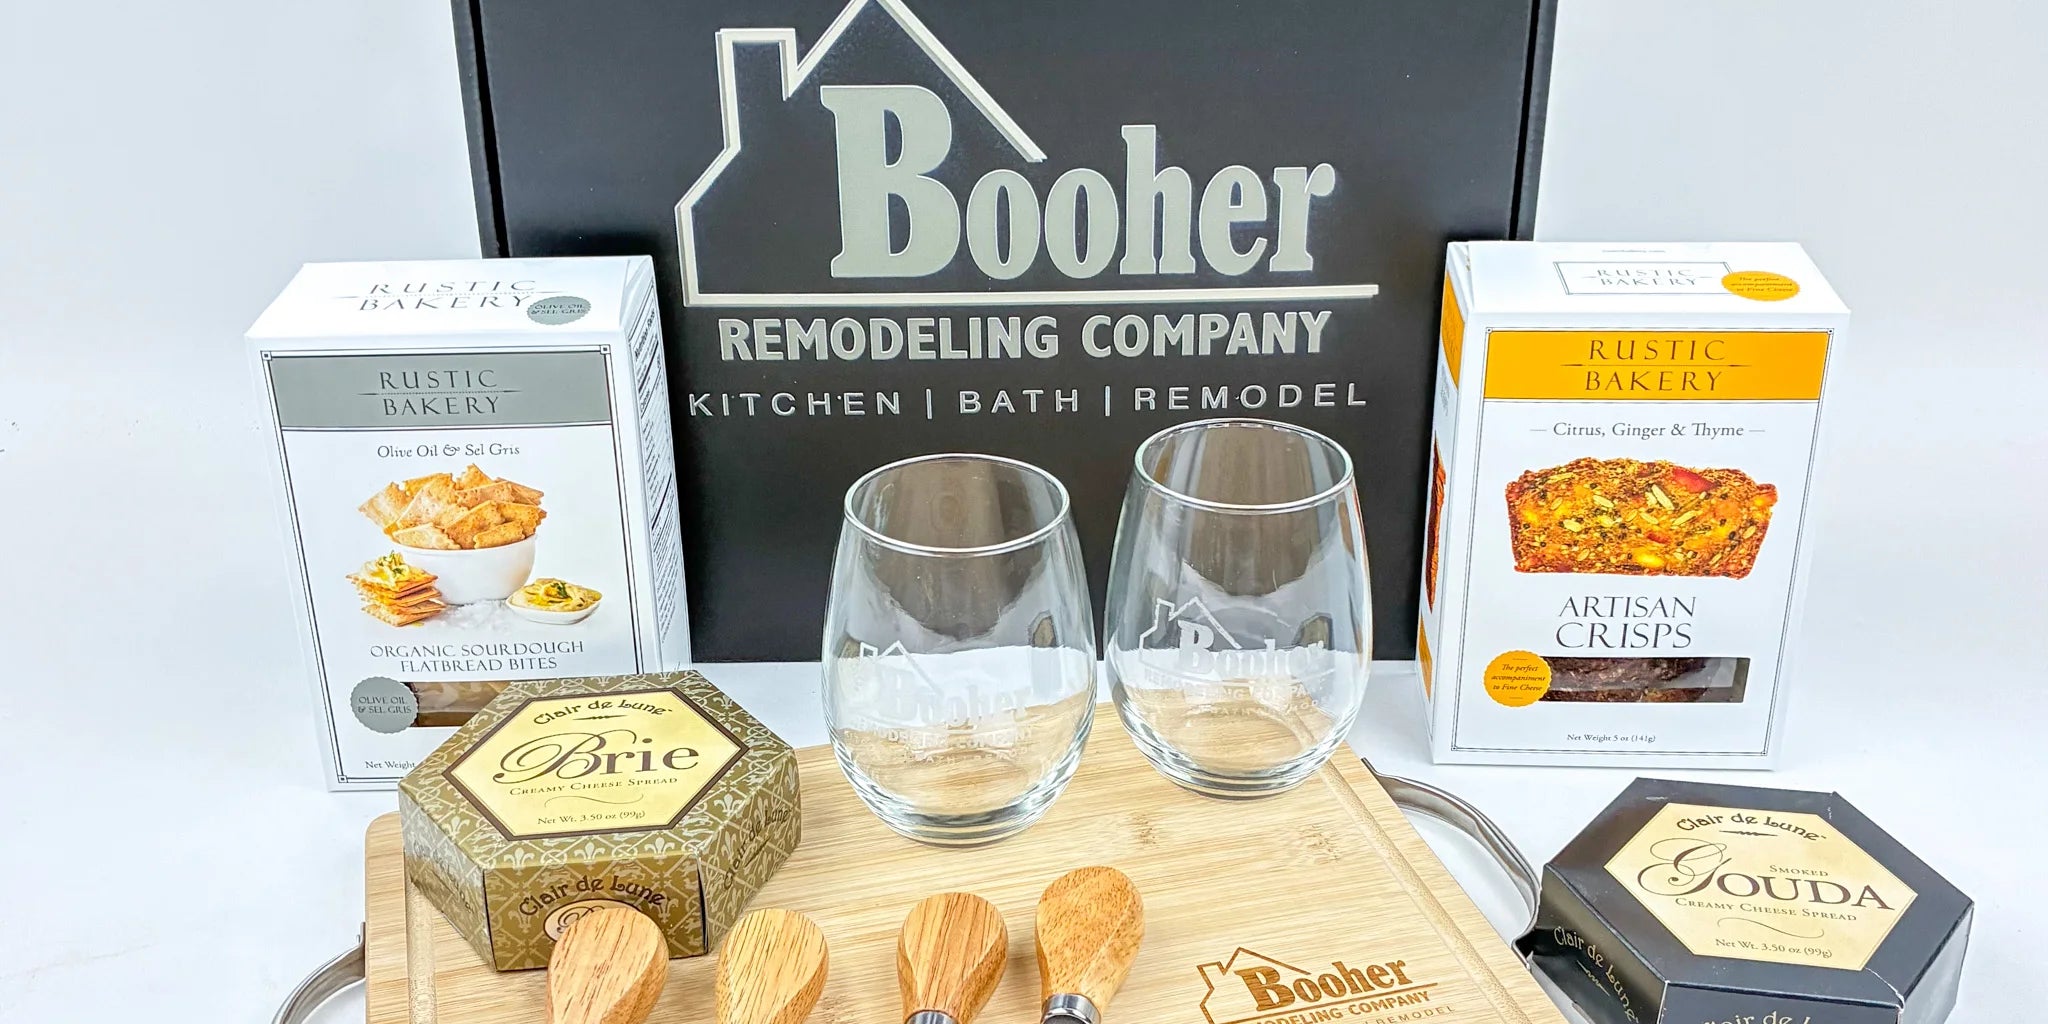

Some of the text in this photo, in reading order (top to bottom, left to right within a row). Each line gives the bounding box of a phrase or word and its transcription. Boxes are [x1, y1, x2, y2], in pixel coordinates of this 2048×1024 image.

[819, 83, 1337, 280] Booher
[1596, 269, 1694, 277] RUSTIC
[1600, 278, 1697, 286] BAKERY
[369, 280, 536, 294] RUSTIC
[359, 296, 531, 311] BAKERY
[718, 310, 1333, 362] REMODELING COMPANY
[1588, 339, 1726, 361] RUSTIC
[379, 369, 498, 390] RUSTIC
[1585, 370, 1724, 392] BAKERY
[383, 396, 500, 417] BAKERY
[689, 390, 901, 417] KITCHEN
[959, 388, 1079, 415] BATH
[1134, 382, 1368, 412] REMODEL
[1553, 422, 1745, 442] Citrus, Ginger & Thyme
[377, 443, 520, 458] Olive Oil & Sel Gris
[1558, 596, 1697, 618] ARTISAN
[1556, 622, 1692, 649] CRISPS
[369, 640, 584, 658] ORGANIC SOURDOUGH
[1178, 619, 1325, 677] Booher
[400, 657, 558, 673] FLATBREAD BITES
[1502, 663, 1539, 673] The perfect
[357, 706, 367, 714] &
[369, 706, 386, 714] SEL
[358, 696, 406, 705] OLIVE OIL
[533, 698, 667, 726] Clair de Lune
[1584, 734, 1612, 743] Weight
[1613, 734, 1618, 742] 5
[1631, 734, 1656, 743] (141g)
[364, 760, 415, 770] Net Weight
[492, 729, 700, 785] Brie
[509, 776, 678, 796] CREAMY CHEESE SPREAD
[537, 810, 646, 825] Net Wt. 3.50 oz (99g)
[1677, 813, 1819, 841] Clair de Lune
[1636, 837, 1895, 911] GOUDA
[1769, 864, 1829, 877] SMOKED
[519, 875, 666, 916] Clair de Lune
[1675, 897, 1857, 922] CREAMY CHEESE SPREAD
[1715, 938, 1832, 959] Net Wt. 3.50 oz (99g)
[1553, 926, 1636, 1022] Clair de Lune
[1233, 959, 1413, 1012] Booher
[1348, 991, 1430, 1016] COMPANY
